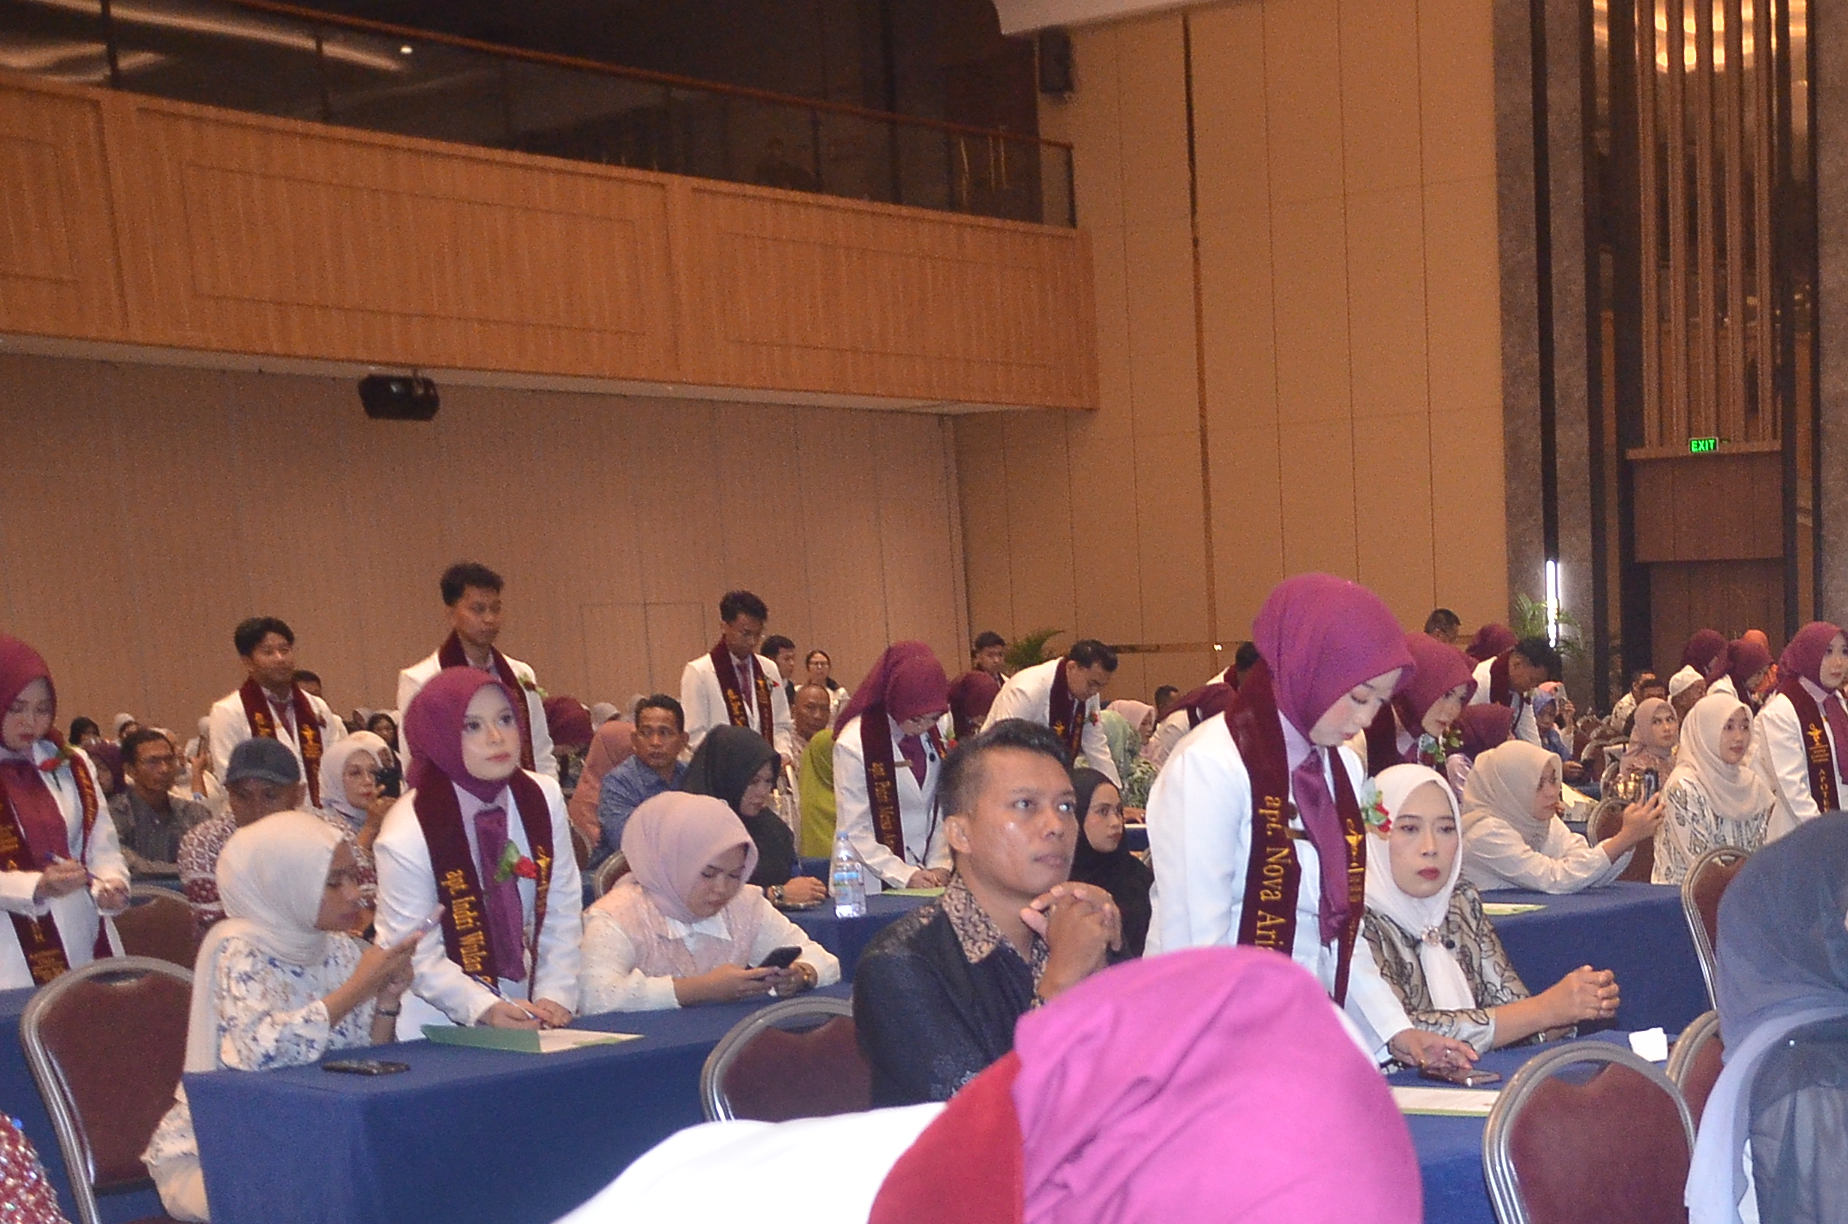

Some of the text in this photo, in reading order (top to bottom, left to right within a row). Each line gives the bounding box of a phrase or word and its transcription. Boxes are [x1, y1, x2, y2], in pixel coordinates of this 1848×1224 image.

[1691, 439, 1716, 452] EXIT
[441, 869, 469, 895] apt.
[1254, 795, 1292, 952] apt. Nova Ari
[451, 896, 481, 931] Indri
[459, 930, 488, 972] Wulan
